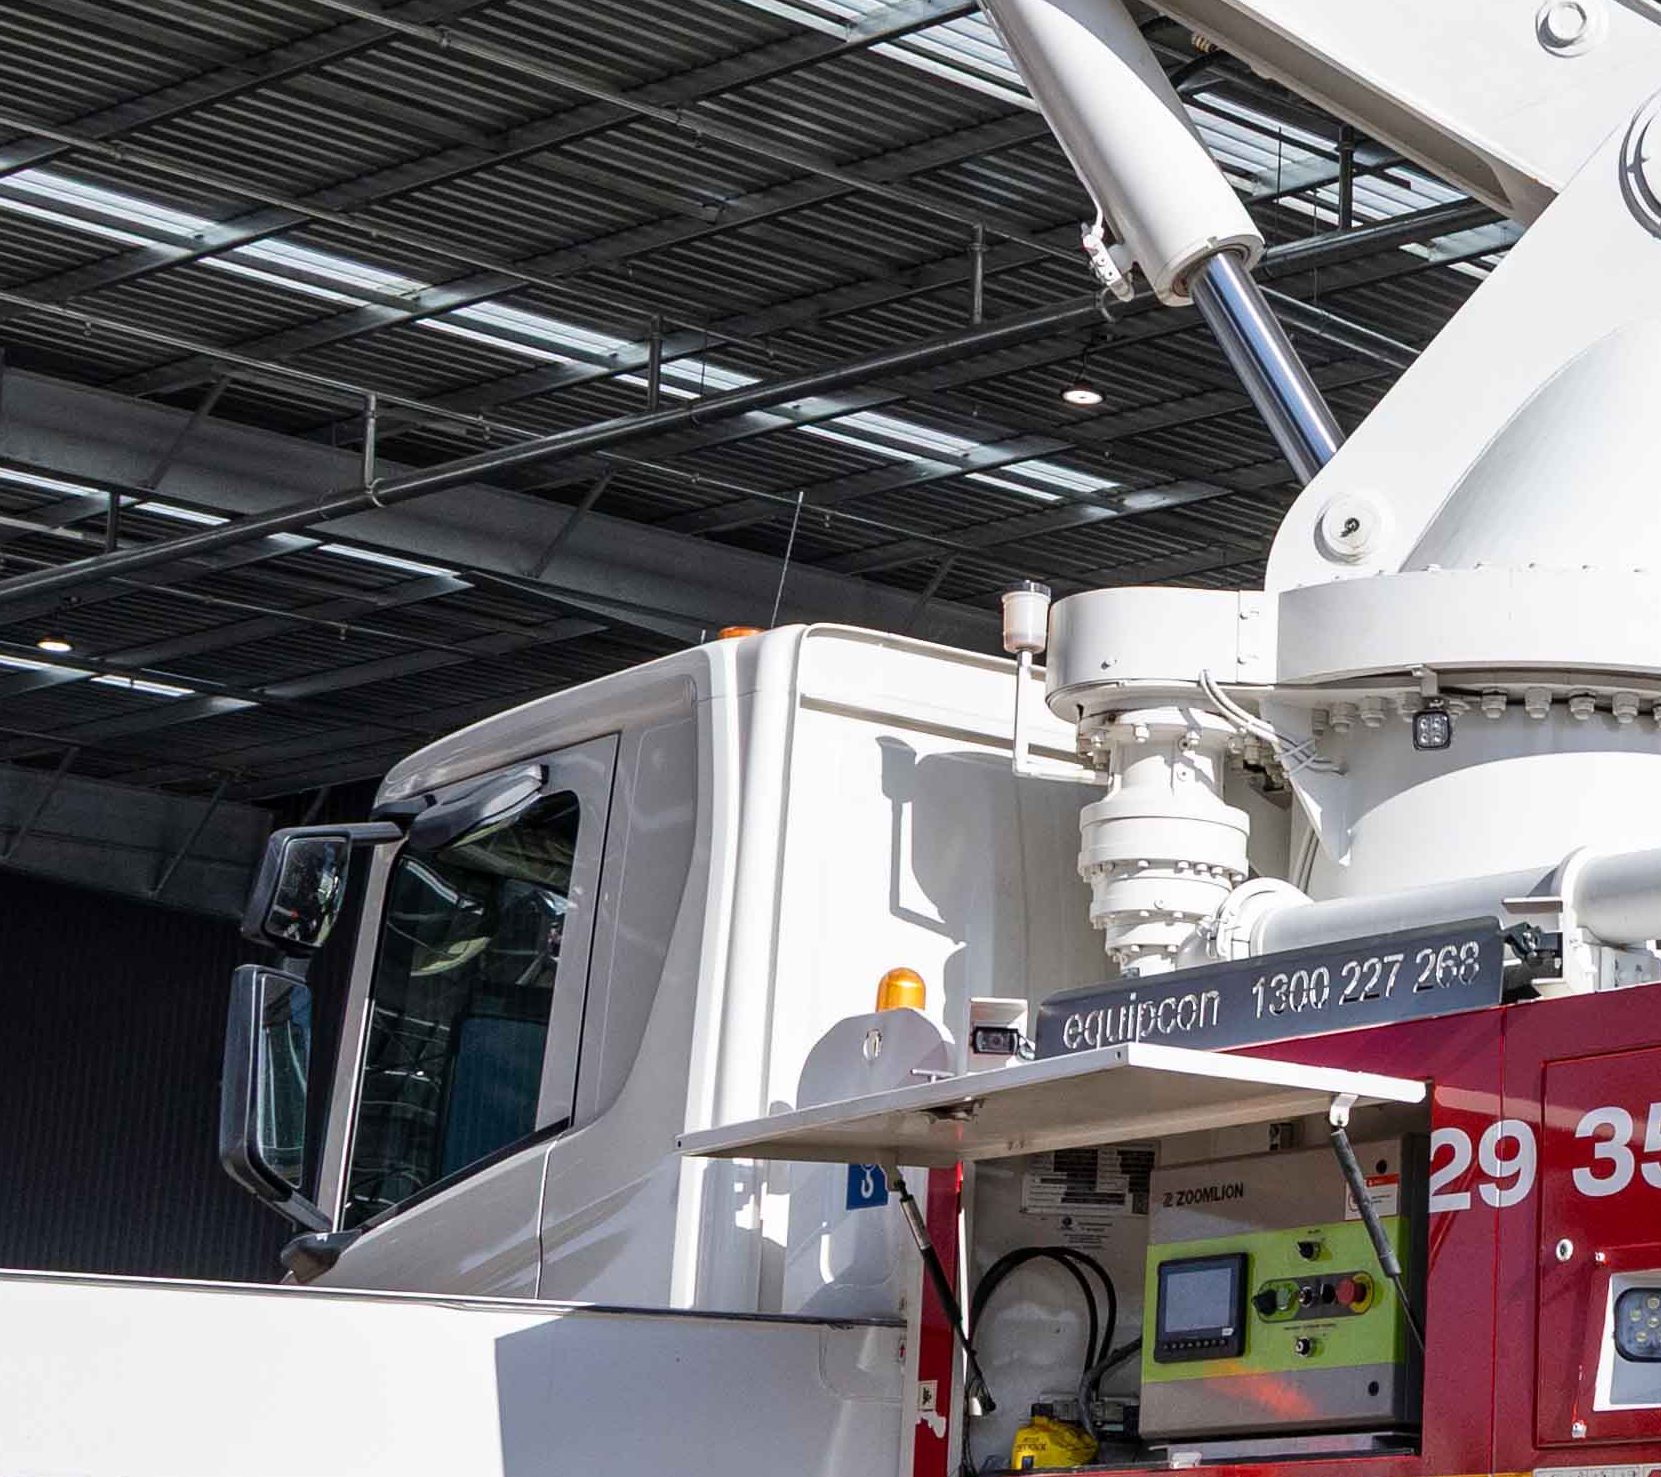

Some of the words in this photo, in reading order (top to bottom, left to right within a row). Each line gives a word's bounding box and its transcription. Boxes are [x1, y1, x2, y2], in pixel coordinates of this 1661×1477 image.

[1062, 988, 1220, 1050] equipcon
[1252, 964, 1332, 1020] 1300
[1339, 953, 1405, 1005] 227
[1414, 941, 1480, 993] 268
[1176, 1183, 1244, 1206] ZOOMLION
